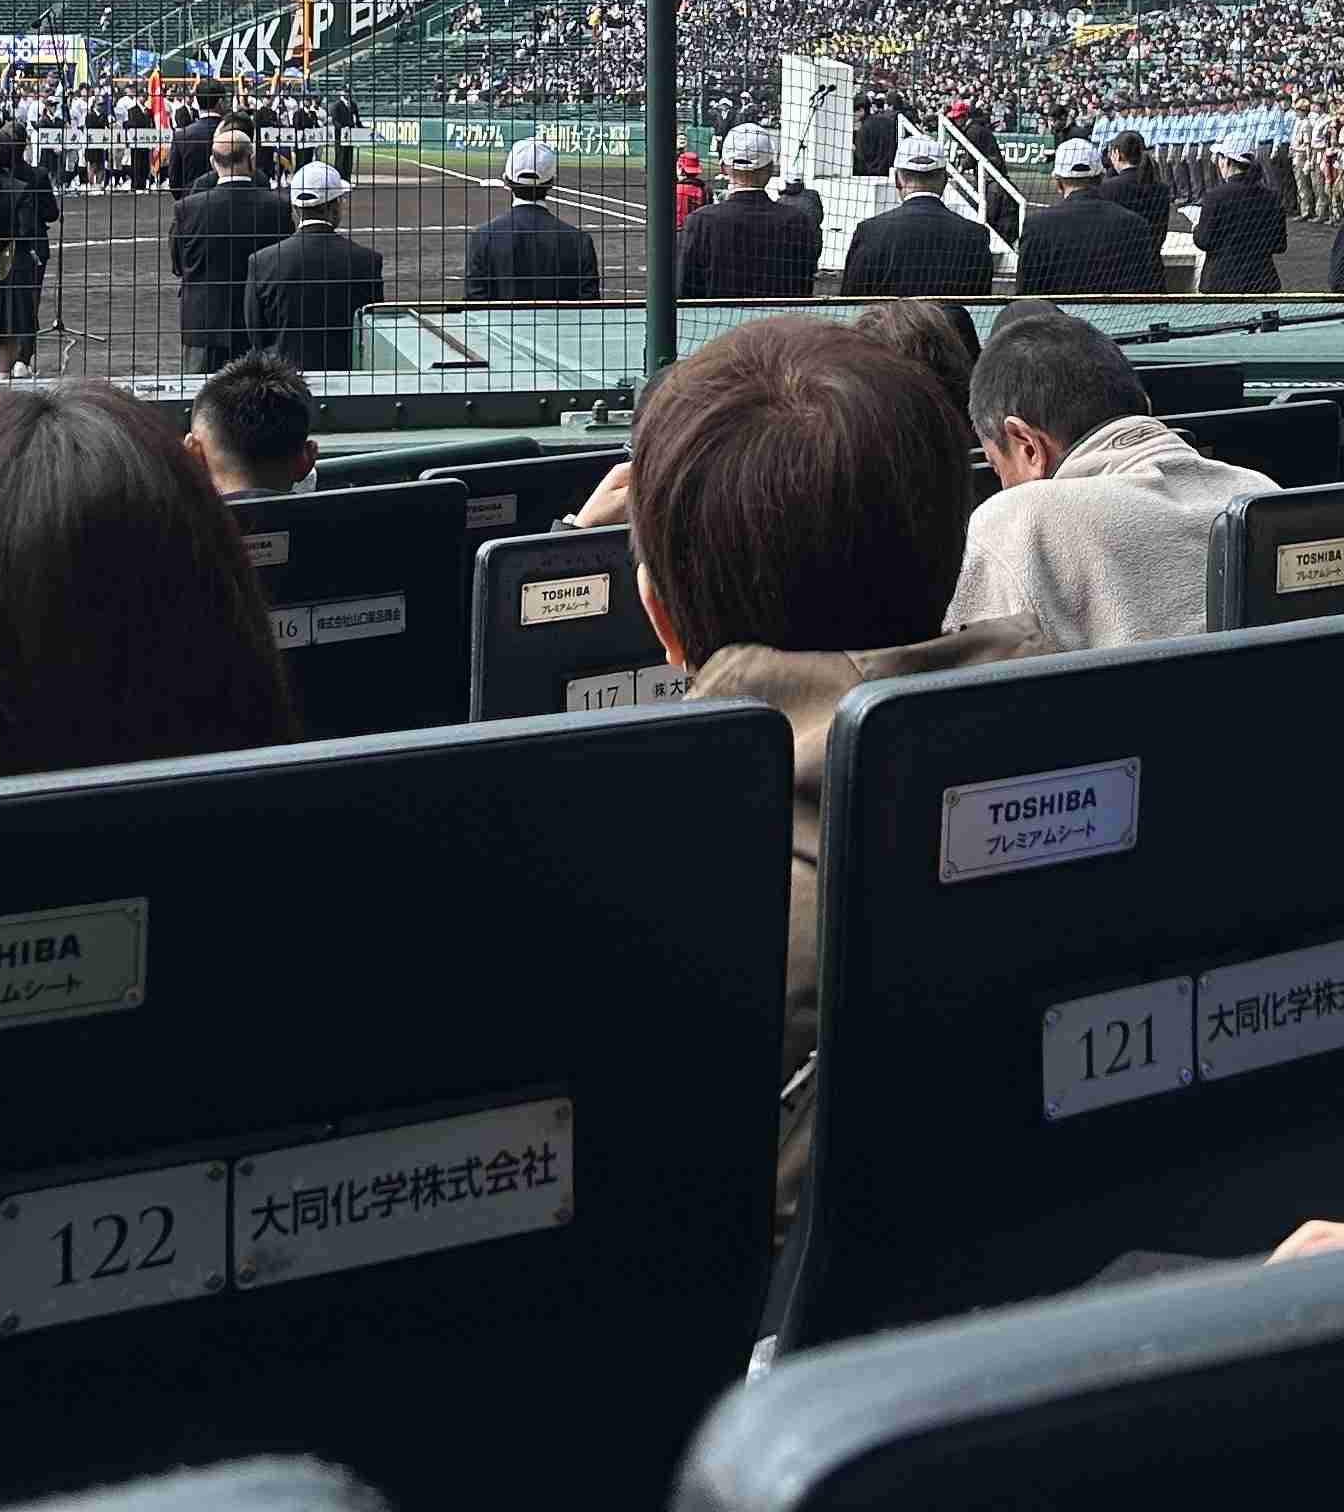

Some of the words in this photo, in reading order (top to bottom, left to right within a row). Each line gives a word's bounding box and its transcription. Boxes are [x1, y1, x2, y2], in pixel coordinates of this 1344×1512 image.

[203, 22, 282, 77] YKK
[1296, 549, 1343, 567] TOSHIBA
[542, 585, 591, 601] TOSHIBA
[582, 685, 619, 712] 117
[988, 787, 1098, 826] TOSHIBA
[985, 820, 1097, 855] プレミアムシート
[1077, 1013, 1157, 1082] 121
[251, 1142, 559, 1242] 大同化学株式会社
[51, 1206, 177, 1287] 122
